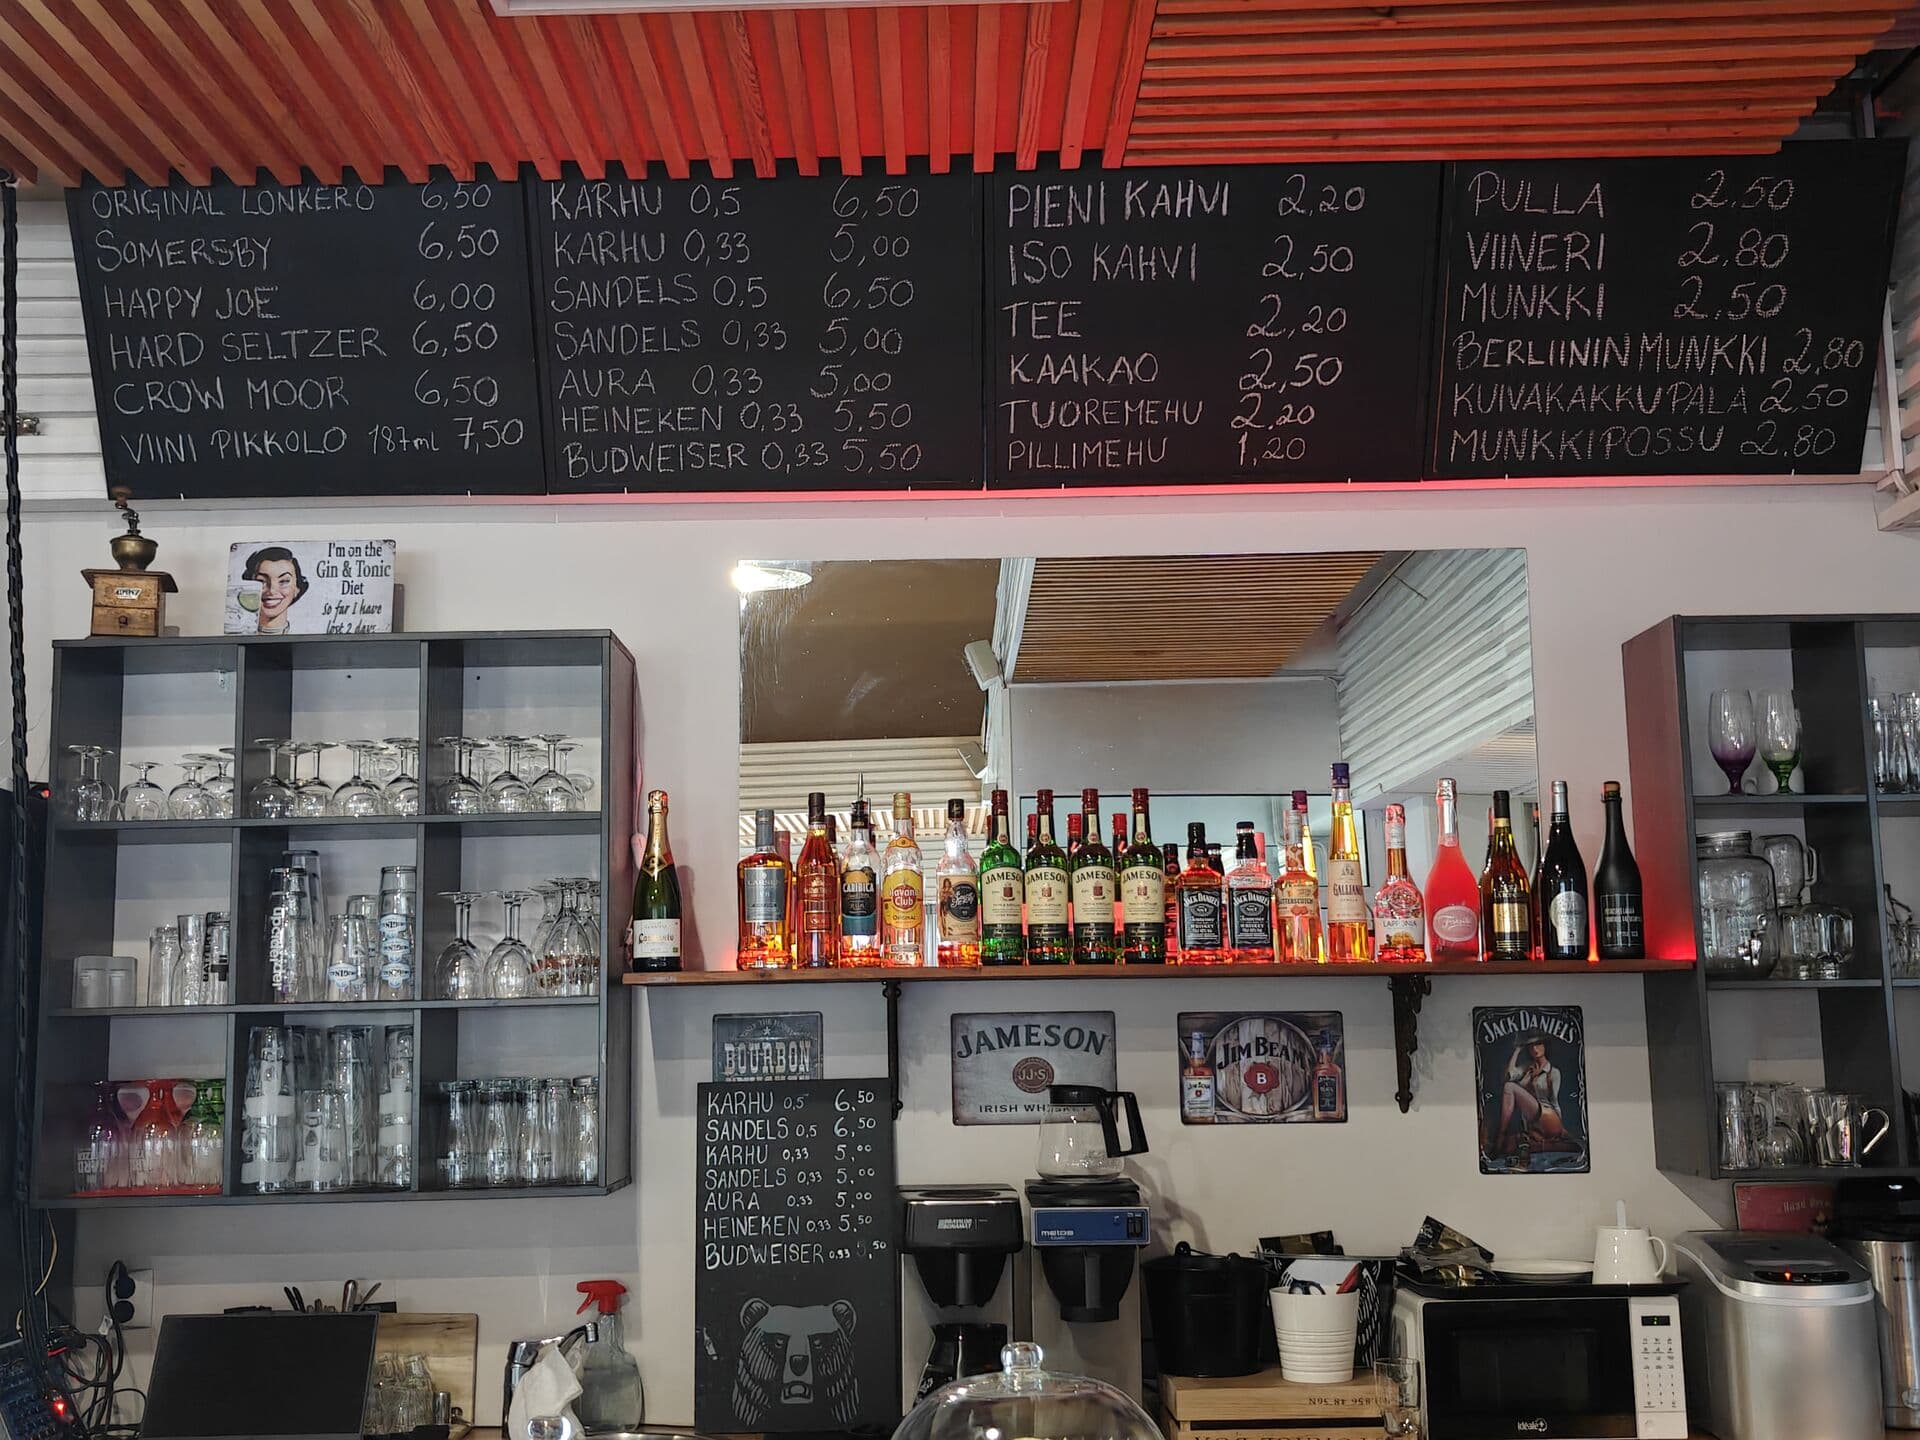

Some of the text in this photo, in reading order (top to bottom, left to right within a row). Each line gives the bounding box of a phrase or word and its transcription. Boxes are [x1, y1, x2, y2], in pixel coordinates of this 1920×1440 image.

[91, 179, 492, 221] ORIGINAL LONKERO 6,50
[550, 176, 920, 221] KARHU 0,5 6,50
[1009, 174, 1366, 228] PIENI KAHVI 2,20
[1467, 170, 1794, 218] PULLA 2,50
[95, 222, 500, 272] SOMERSBY 6,50
[553, 223, 910, 268] KARHU 0,33 5,00
[1009, 234, 1354, 286] ISO KAHVI 2,50
[1467, 221, 1790, 272] VIINERI 2,80
[105, 280, 496, 319] HAPPY JOE 6,00
[550, 272, 914, 313] SANDELS 0,5 6,50
[1461, 275, 1787, 322] MUNKKI 2,50
[1002, 293, 1347, 340] TEE 2,20
[110, 321, 498, 370] HARD SELTZER 6,50
[553, 317, 903, 361] SANDELS 0,33 5,00
[1638, 333, 1768, 375] MUNKKI
[1782, 327, 1865, 375] 2,80
[558, 364, 892, 400] AURA 0,33 5,00
[1010, 348, 1344, 394] KAAKAO 2,50
[112, 369, 499, 414] CROW MOOR 6,50
[1759, 377, 1848, 413] 2,50
[560, 399, 912, 436] HEINEKEN 0,33 5,50
[1000, 392, 1316, 434] TUOREMEHU 2,20
[120, 433, 198, 464] VIINI
[210, 426, 347, 458] PIKKOLO
[452, 417, 524, 455] 7,50
[1009, 432, 1306, 471] PILLIMEHU 1,20
[1740, 419, 1836, 457] 2,80
[563, 437, 922, 479] BUDWEISER 0,33 5,50
[329, 542, 382, 557] I'm on the
[317, 560, 391, 578] Gin & Tonic
[342, 581, 364, 595] Diet
[360, 600, 382, 615] have
[1026, 871, 1066, 884] JAMESON
[1122, 871, 1161, 883] JAMESON
[894, 896, 914, 906] Club
[957, 1024, 1109, 1058] JAMESON
[1483, 1009, 1577, 1044] JACK DANIEL'S
[724, 1041, 811, 1075] BOURBON
[1217, 1037, 1306, 1069] JIM BEAM
[1257, 1073, 1267, 1084] B
[707, 1089, 874, 1116] KARHU 0,5 6,50
[979, 1104, 1018, 1113] IRISH
[705, 1117, 876, 1142] SANDELS 0,5 6,50
[706, 1144, 872, 1166] KARHU 0,33 5,00
[705, 1168, 787, 1190] SANDELS
[797, 1171, 823, 1186] 0,33
[704, 1191, 760, 1212] AURA
[704, 1216, 799, 1240] HEINEKEN
[806, 1219, 831, 1232] 0,33
[705, 1243, 824, 1270] BUDWEISER
